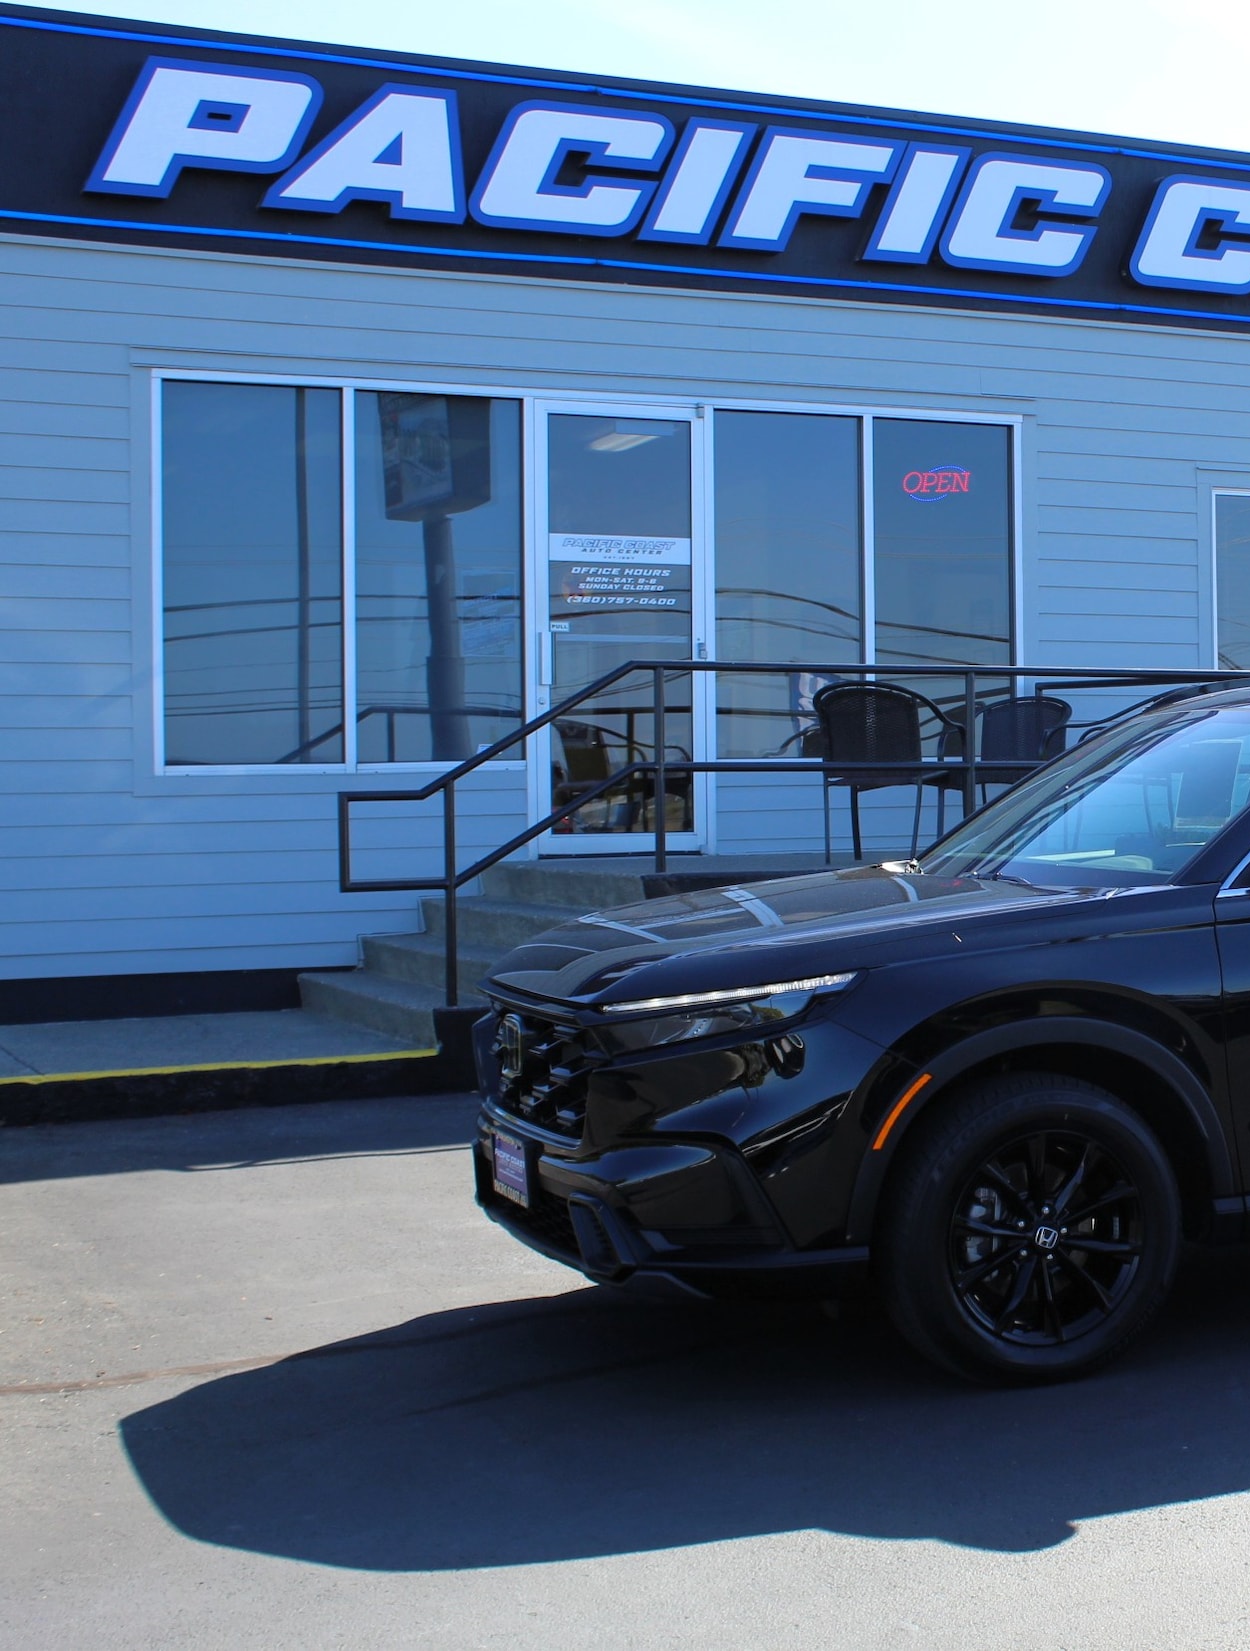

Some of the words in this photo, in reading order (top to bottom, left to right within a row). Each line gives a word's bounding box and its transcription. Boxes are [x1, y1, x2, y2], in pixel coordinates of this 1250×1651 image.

[84, 56, 1112, 277] PACIFIC
[902, 471, 971, 493] OPEN
[562, 537, 622, 549] PACIFIC
[623, 539, 676, 551] COAST
[571, 567, 621, 576] OFFICE
[624, 568, 671, 577] HOURS
[578, 583, 620, 591] SUNDAY
[622, 584, 664, 592] CLOSED
[566, 596, 676, 606] (360)757-0400
